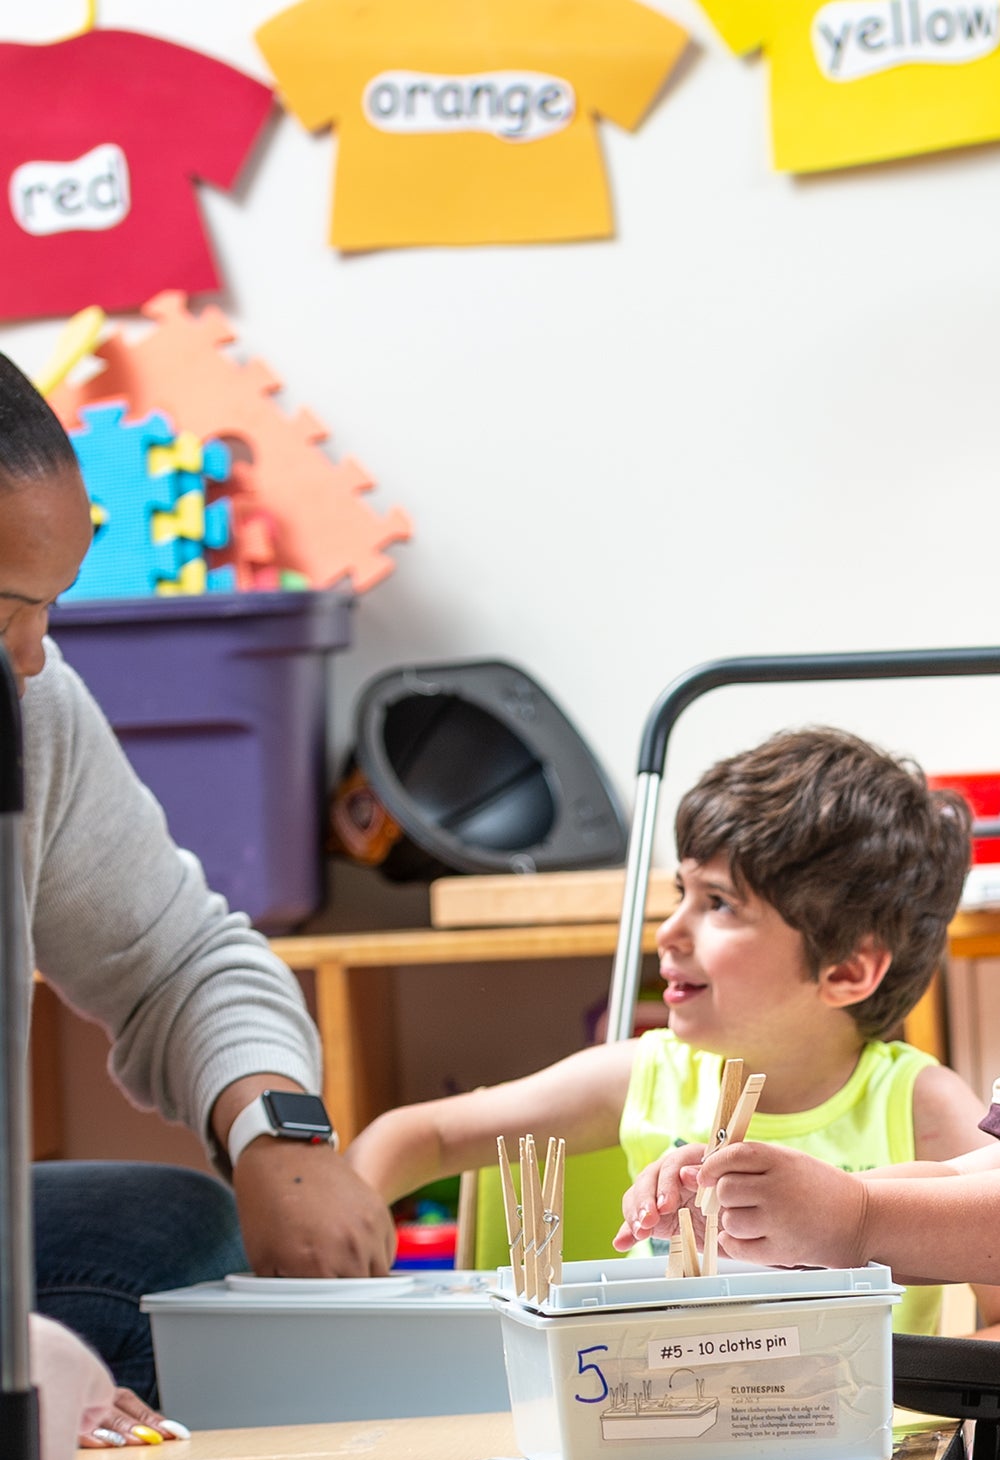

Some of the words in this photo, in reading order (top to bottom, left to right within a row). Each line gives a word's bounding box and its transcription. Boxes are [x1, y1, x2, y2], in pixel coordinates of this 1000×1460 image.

[819, 0, 996, 73] yellow
[367, 80, 571, 139] orange
[20, 152, 121, 219] red
[575, 1345, 608, 1403] 5
[661, 1345, 683, 1359] #5
[699, 1341, 714, 1355] 10
[719, 1338, 761, 1353] cloths
[766, 1335, 787, 1351] pin
[731, 1385, 785, 1394] CLOTHESPINS
